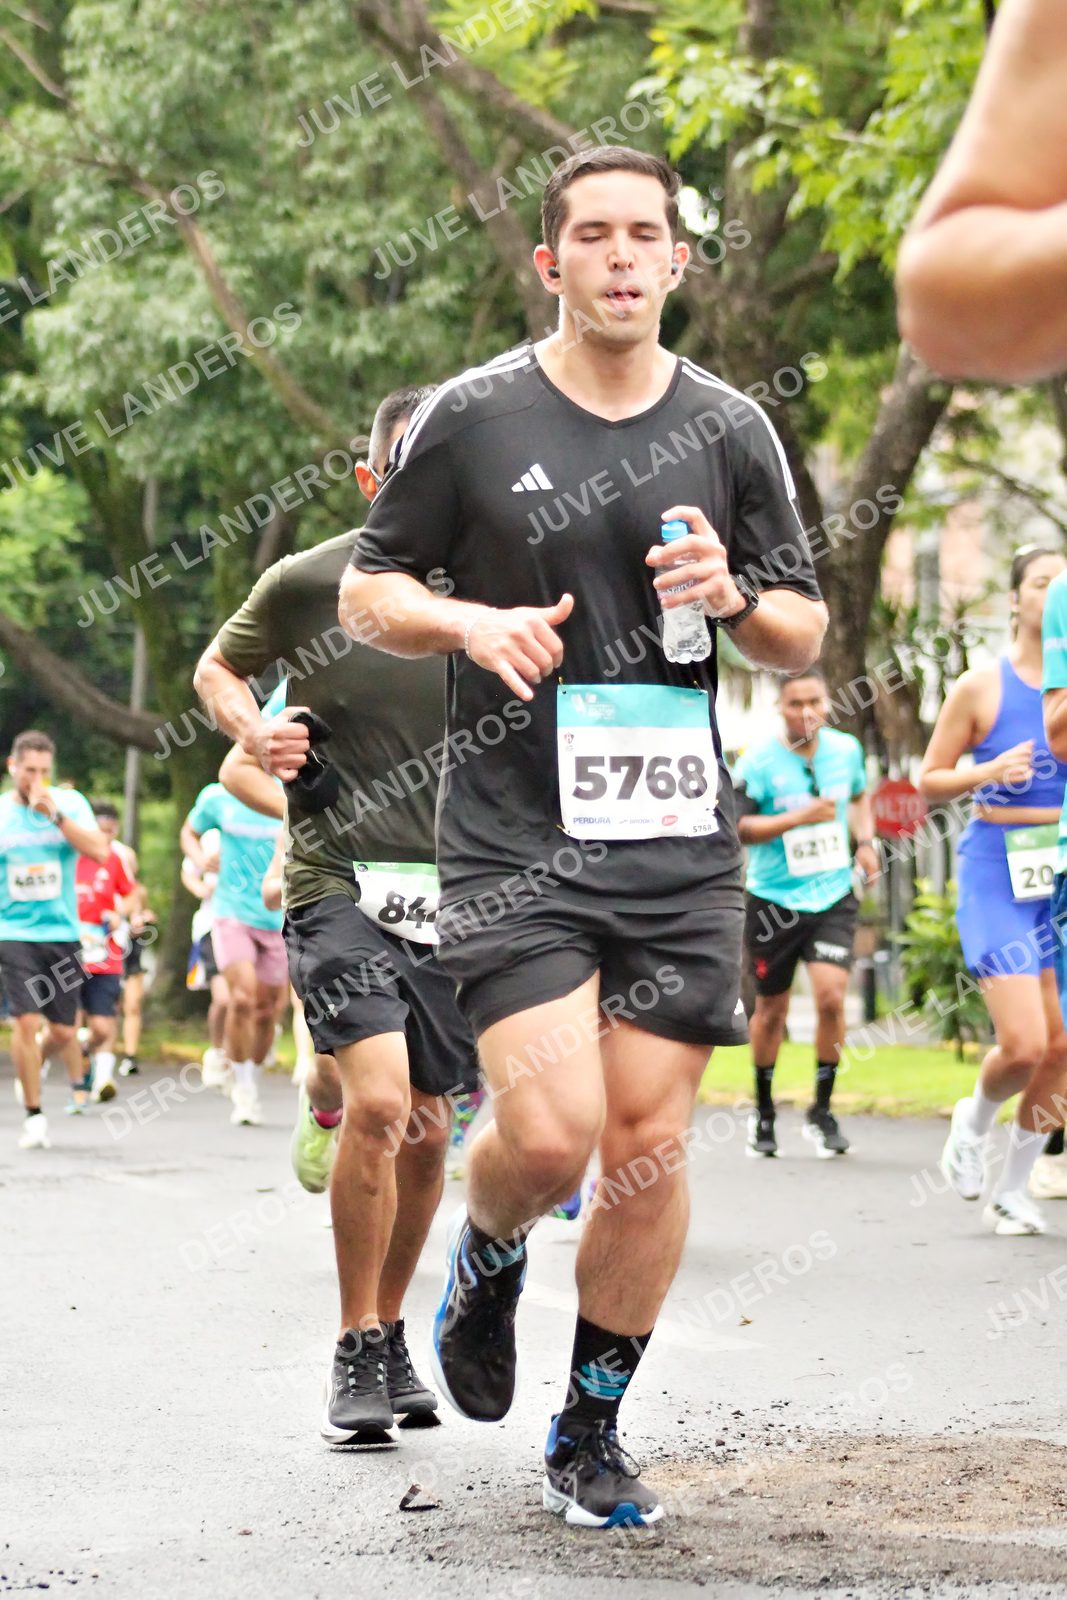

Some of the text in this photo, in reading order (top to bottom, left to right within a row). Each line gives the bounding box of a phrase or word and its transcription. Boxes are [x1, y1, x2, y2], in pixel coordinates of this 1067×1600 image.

[572, 755, 707, 801] 5768
[573, 817, 611, 825] PERDURA
[1020, 865, 1054, 889] 20
